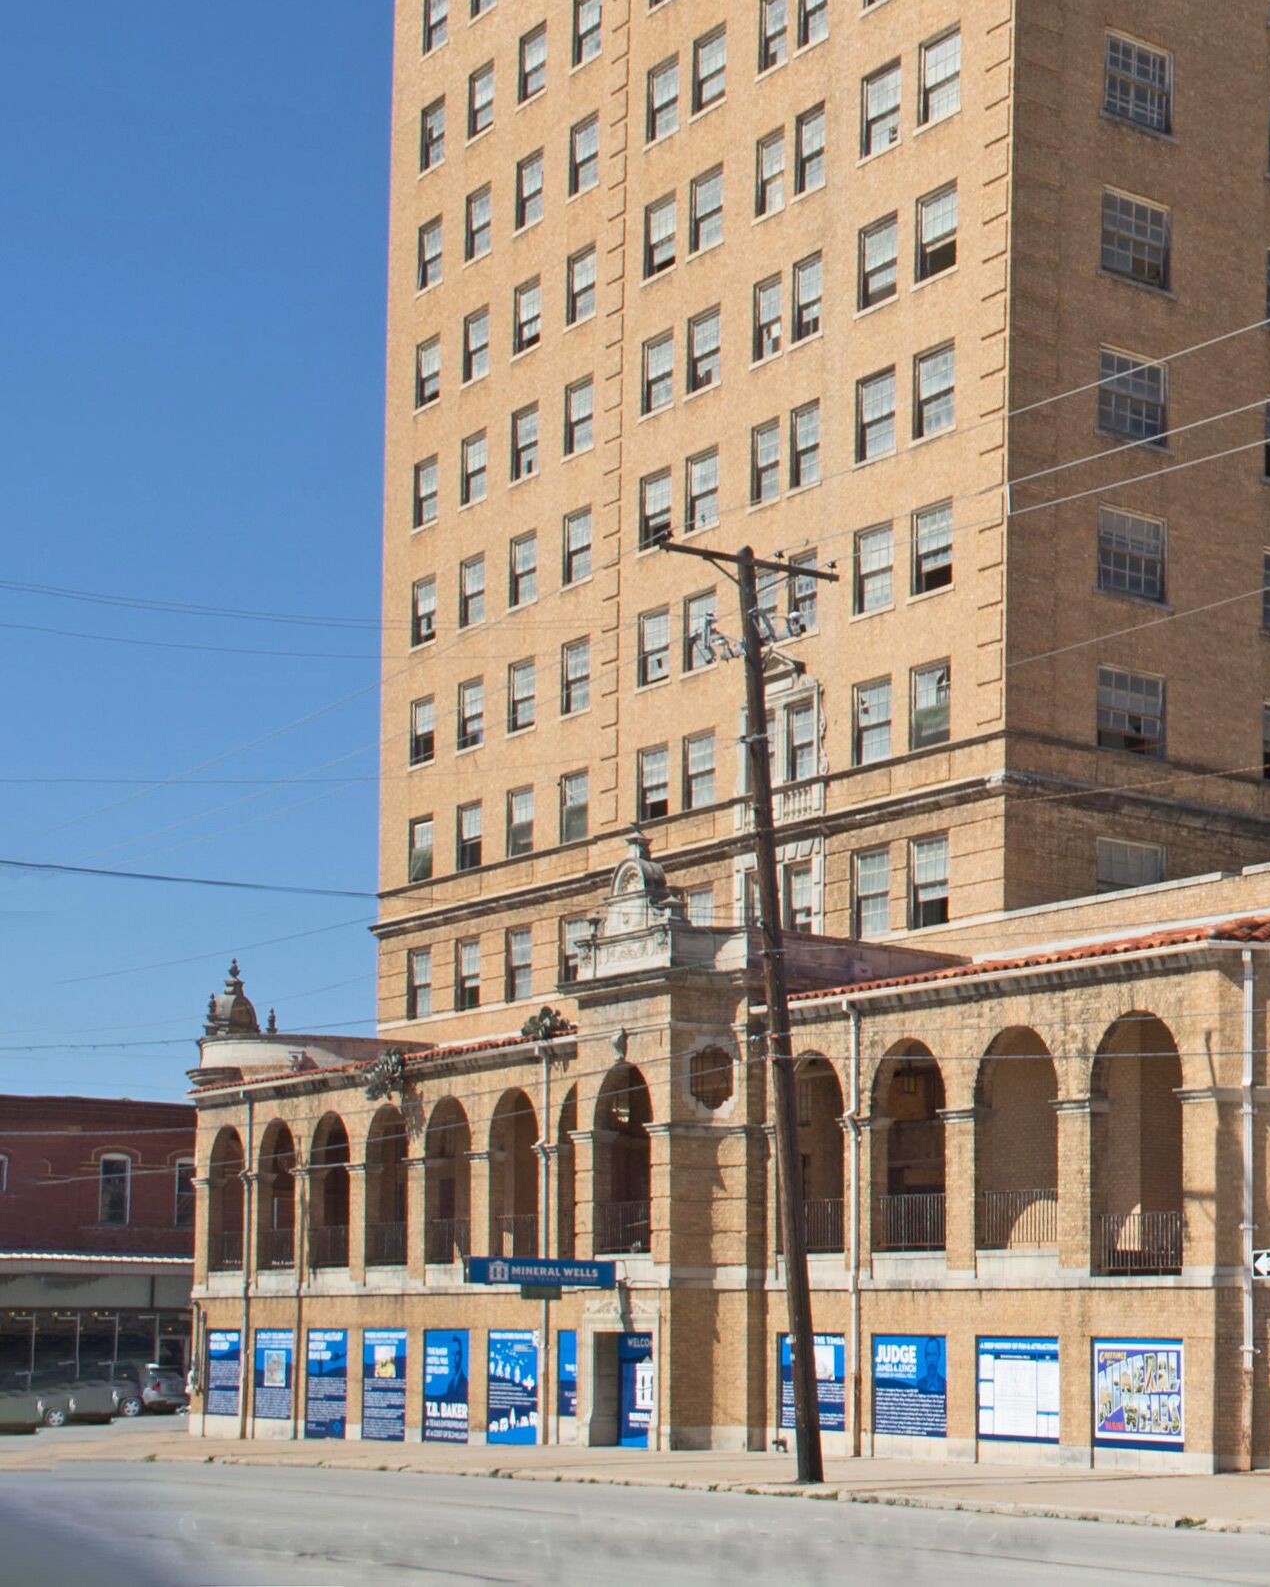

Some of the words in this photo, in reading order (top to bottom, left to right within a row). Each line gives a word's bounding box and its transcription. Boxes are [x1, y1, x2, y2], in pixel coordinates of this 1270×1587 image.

[512, 1266, 561, 1276] MINERAL
[564, 1268, 598, 1278] WELLS
[875, 1344, 917, 1364] JUDGE
[1098, 1352, 1181, 1428] MINERAL
[440, 1402, 468, 1418] BAKER
[1121, 1394, 1181, 1434] WELLS
